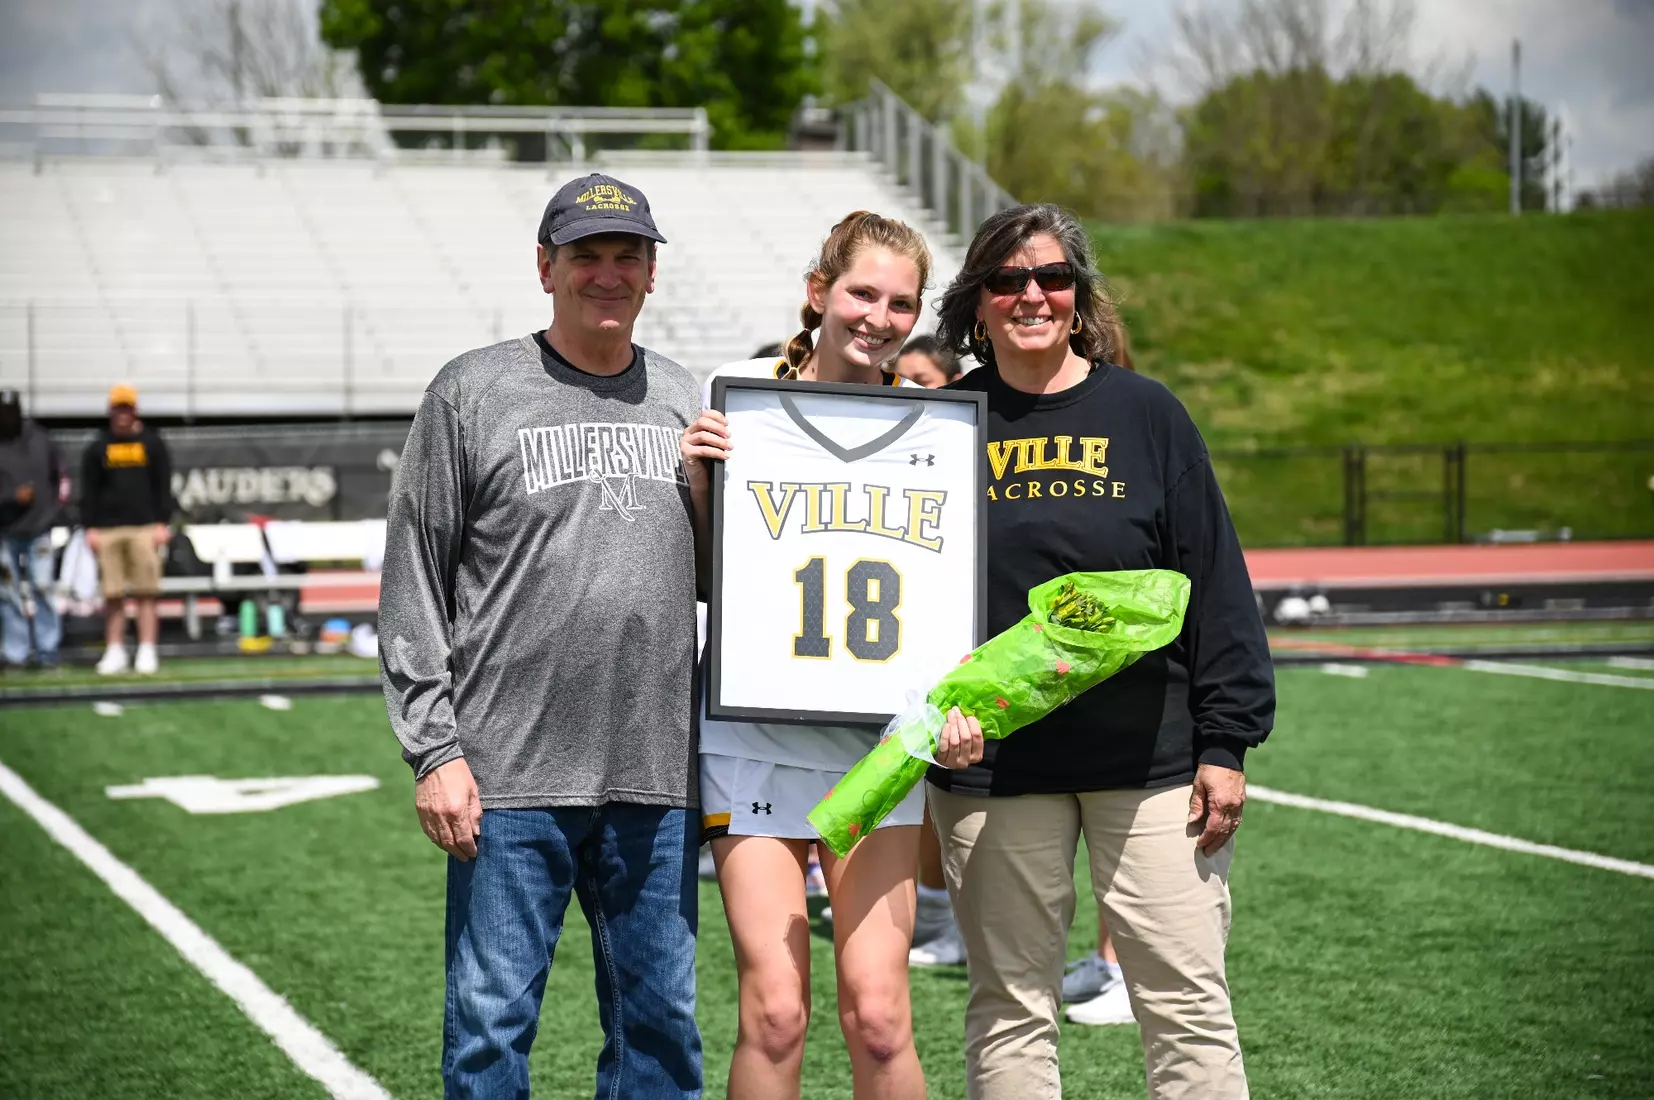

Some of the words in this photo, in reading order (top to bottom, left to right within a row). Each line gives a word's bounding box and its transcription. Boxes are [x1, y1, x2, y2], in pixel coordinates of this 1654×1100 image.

[575, 184, 637, 205] MILLERSVILLE
[585, 203, 630, 212] LACROSSE
[518, 422, 690, 495] MILLERSVILL
[987, 435, 1109, 480] VILLE
[747, 480, 948, 554] VILLE
[791, 555, 903, 664] 18
